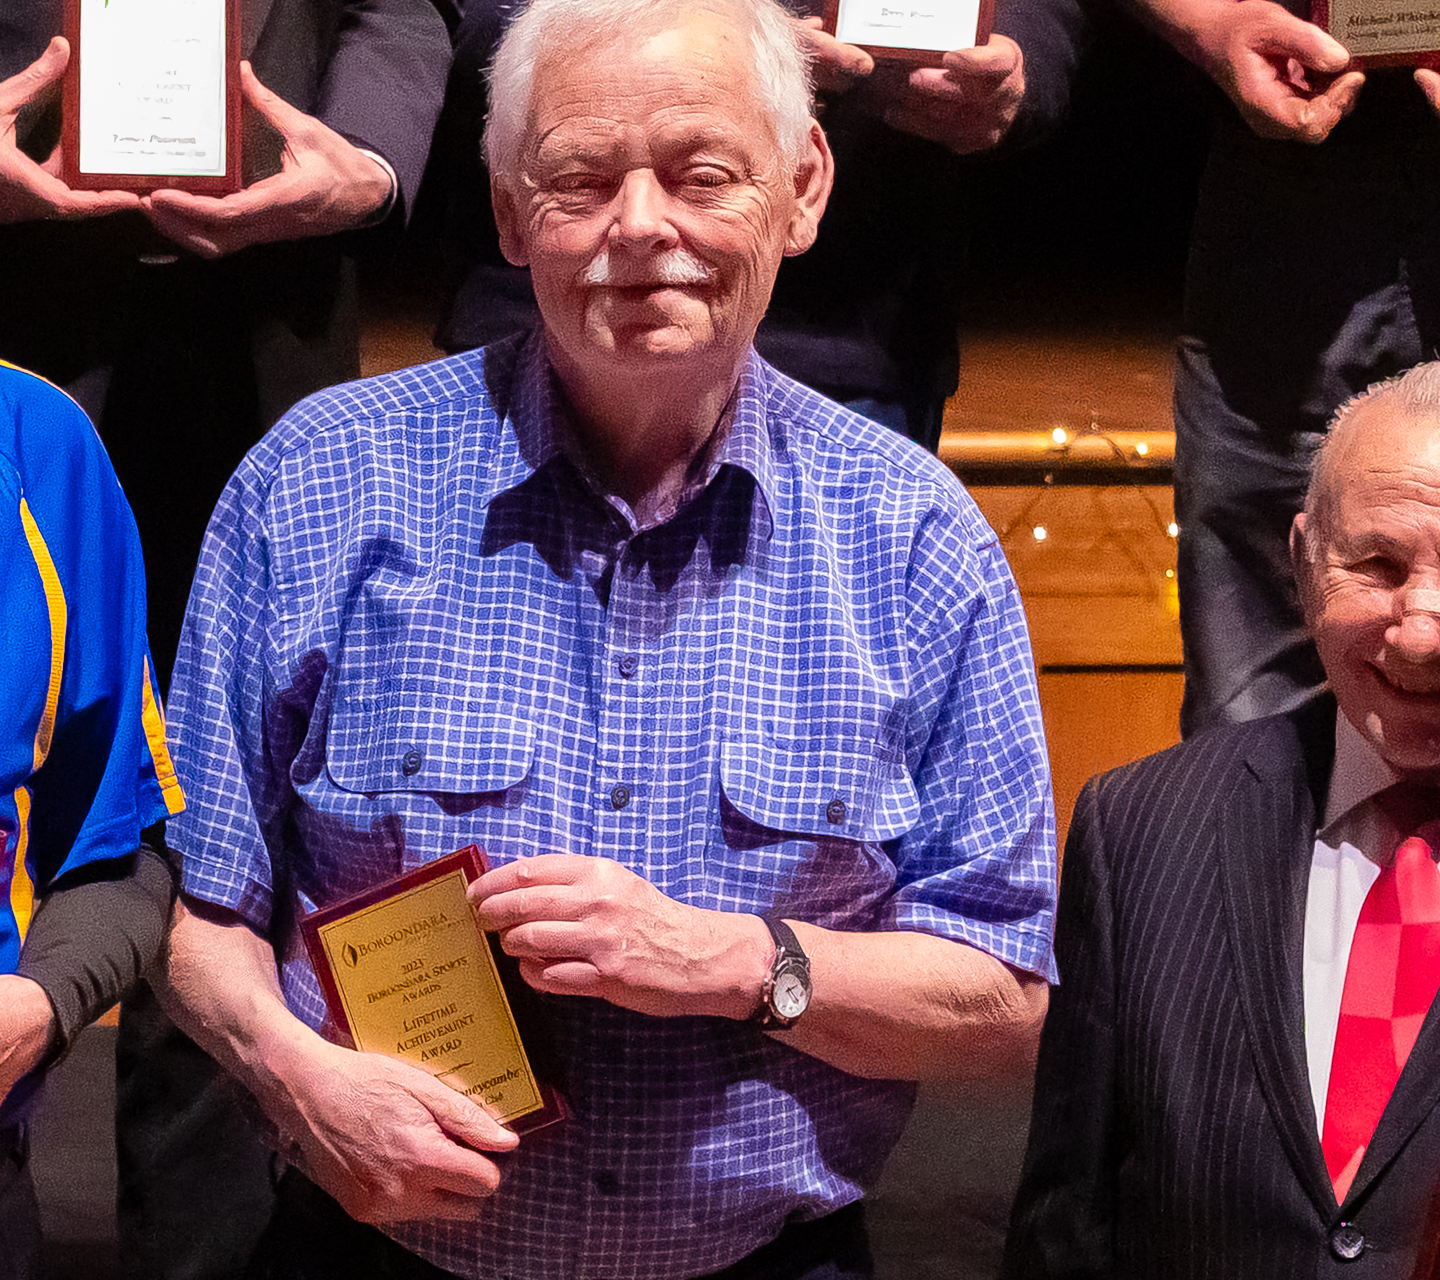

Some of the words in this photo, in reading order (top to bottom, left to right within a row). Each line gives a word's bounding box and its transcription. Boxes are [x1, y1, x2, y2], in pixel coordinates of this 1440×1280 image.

[357, 911, 447, 956] BOROONDARA
[400, 957, 424, 974] 2023
[402, 1001, 458, 1032] LIFETIME
[396, 1013, 474, 1054] ACHIEVEMENT
[420, 1037, 462, 1062] AWARD
